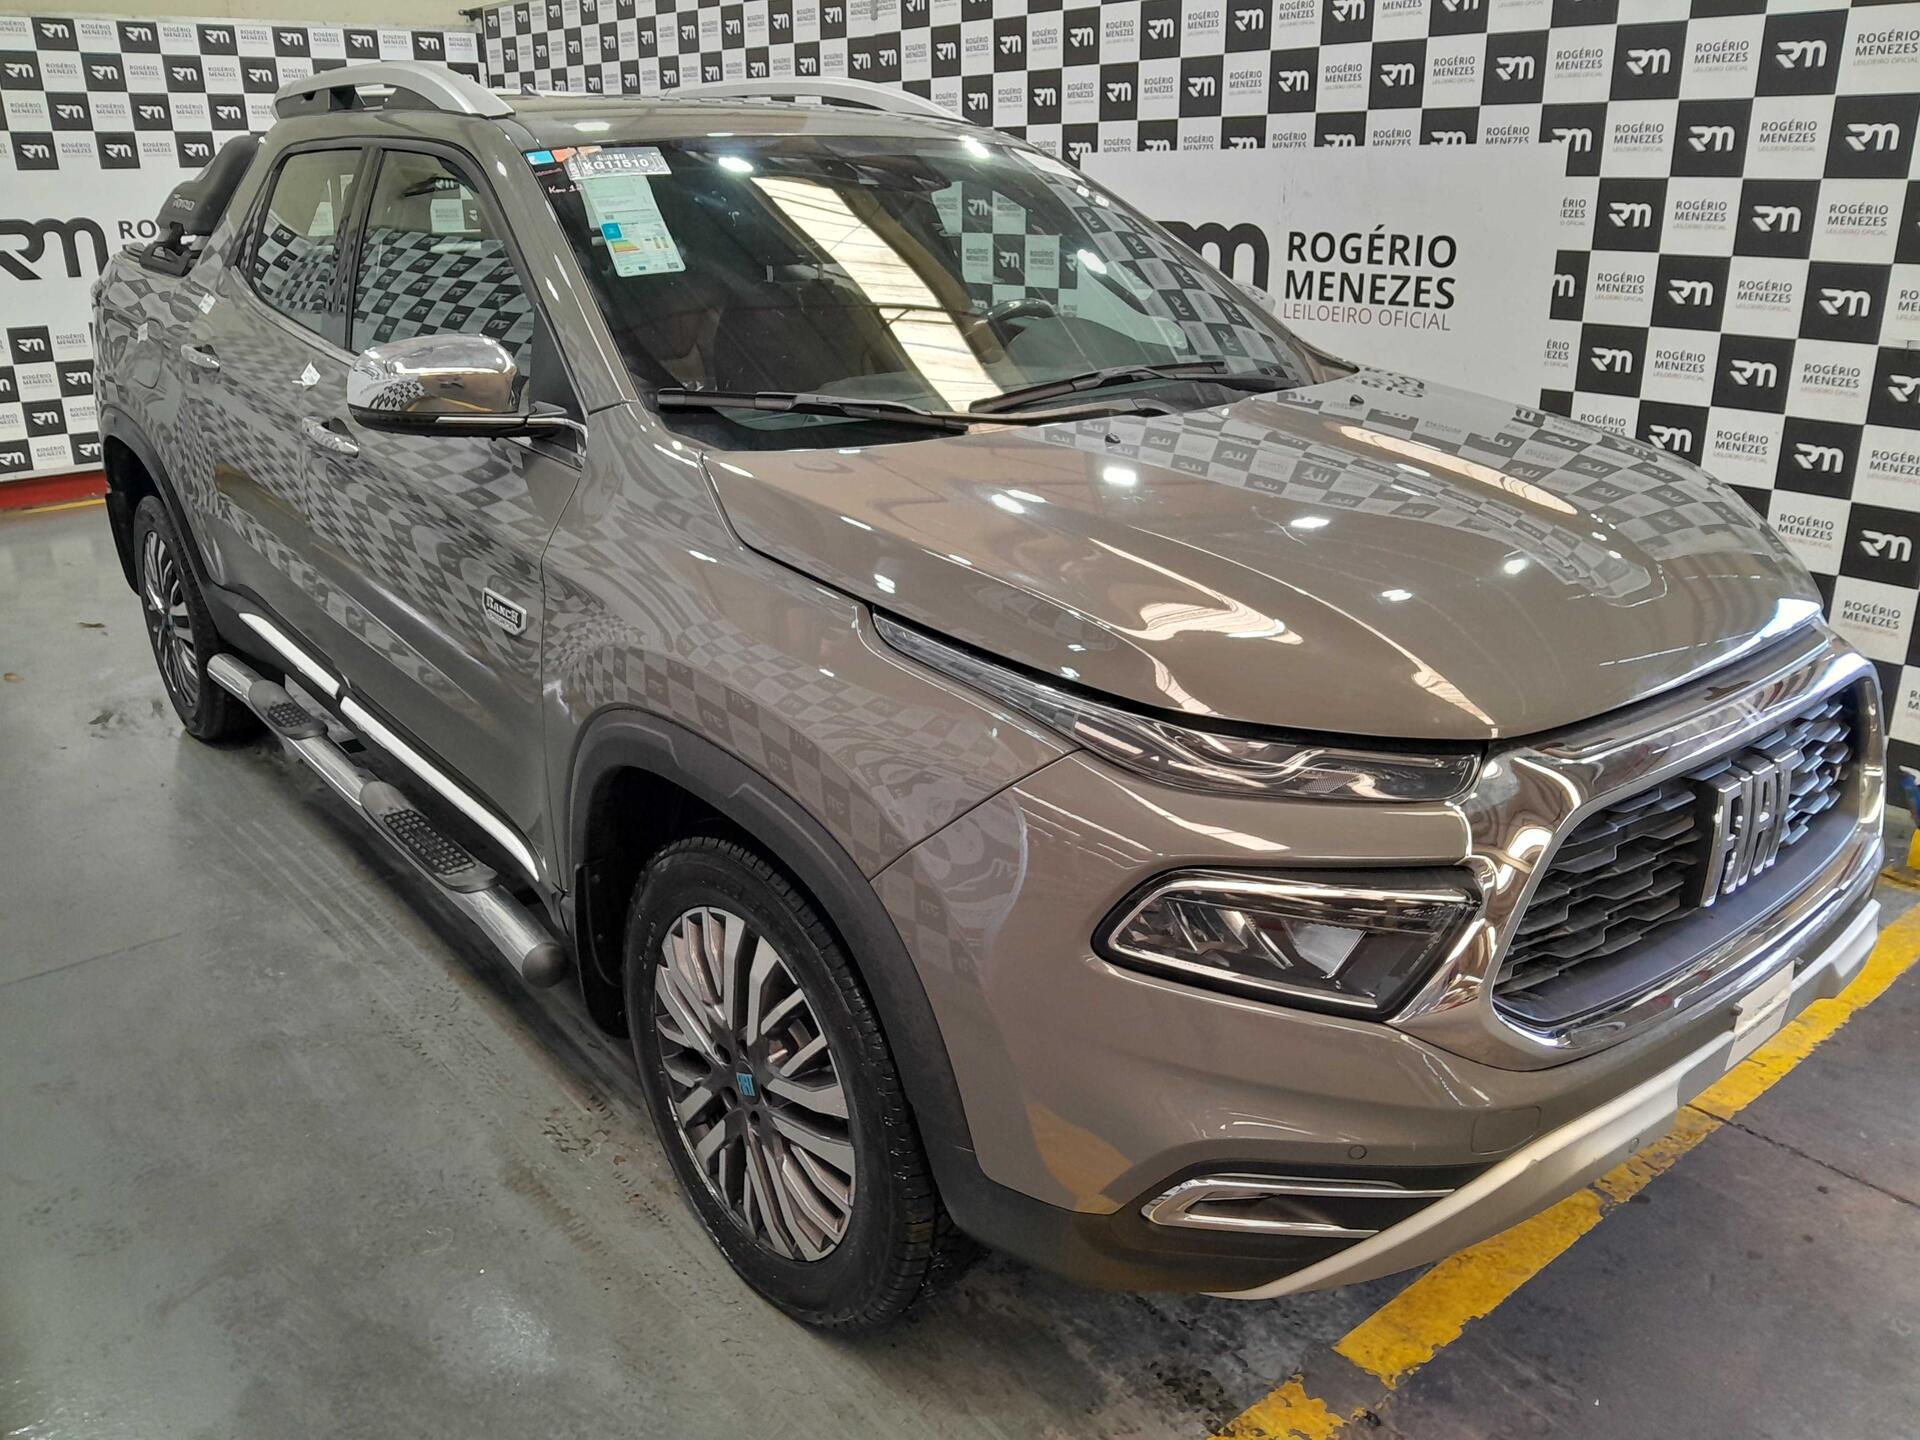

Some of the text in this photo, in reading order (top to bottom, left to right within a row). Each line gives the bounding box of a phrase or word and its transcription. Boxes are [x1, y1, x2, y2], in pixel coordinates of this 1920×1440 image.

[1382, 0, 1422, 11] MENEZES
[1695, 38, 1750, 52] ROGÉRIO
[1853, 44, 1916, 57] MENEZES
[1556, 47, 1603, 60] ROGÉRIO
[1694, 52, 1749, 64] MENEZES
[1433, 55, 1475, 67] ROGÉRIO
[1555, 59, 1603, 71] MENEZES
[1325, 62, 1362, 74] ROGÉRIO
[1433, 67, 1475, 77] MENEZES
[1325, 73, 1362, 83] MENEZES
[1486, 124, 1530, 136] ROGÉRIO
[1614, 121, 1664, 133] ROGÉRIO
[1761, 118, 1818, 131] ROGÉRIO
[1184, 133, 1214, 143] ROGÉRIO
[1273, 131, 1307, 141] ROGÉRIO
[1373, 127, 1411, 138] ROGÉRIO
[1759, 132, 1817, 142] MENEZES
[1104, 136, 1131, 145] ROGÉRIO
[1613, 134, 1664, 144] MENEZES
[1562, 197, 1586, 208] ÉRIO
[1675, 198, 1728, 211] ROGÉRIO
[1829, 201, 1889, 215] ROGÉRIO
[1561, 209, 1586, 218] EZES
[1674, 212, 1727, 222] MENEZES
[1827, 215, 1888, 227] MENEZES
[1287, 225, 1457, 268] ROGÉRIO
[1597, 272, 1645, 284] ROGÉRIO
[1284, 270, 1456, 310] MENEZES
[1596, 283, 1644, 294] MENEZES
[1738, 279, 1793, 292] ROGÉRIO
[1737, 291, 1792, 304] MENEZES
[1283, 302, 1451, 331] LEILOEIRO OFICIAL
[1547, 338, 1570, 350] ÉRIO
[1546, 348, 1569, 360] EZES
[1656, 350, 1706, 363] ROGÉRIO
[1654, 360, 1705, 373] MENEZES
[1803, 363, 1861, 378] ROGÉRIO
[1802, 374, 1860, 389] MENEZES
[1716, 430, 1769, 445] ROGÉRIO
[1714, 440, 1768, 456] MENEZES
[1779, 514, 1834, 531] ROGÉRIO
[1777, 524, 1833, 541] MENEZES
[1843, 600, 1901, 620] ROGÉRIO
[1841, 610, 1900, 630] MENEZES
[1700, 749, 1799, 908] FIAT
